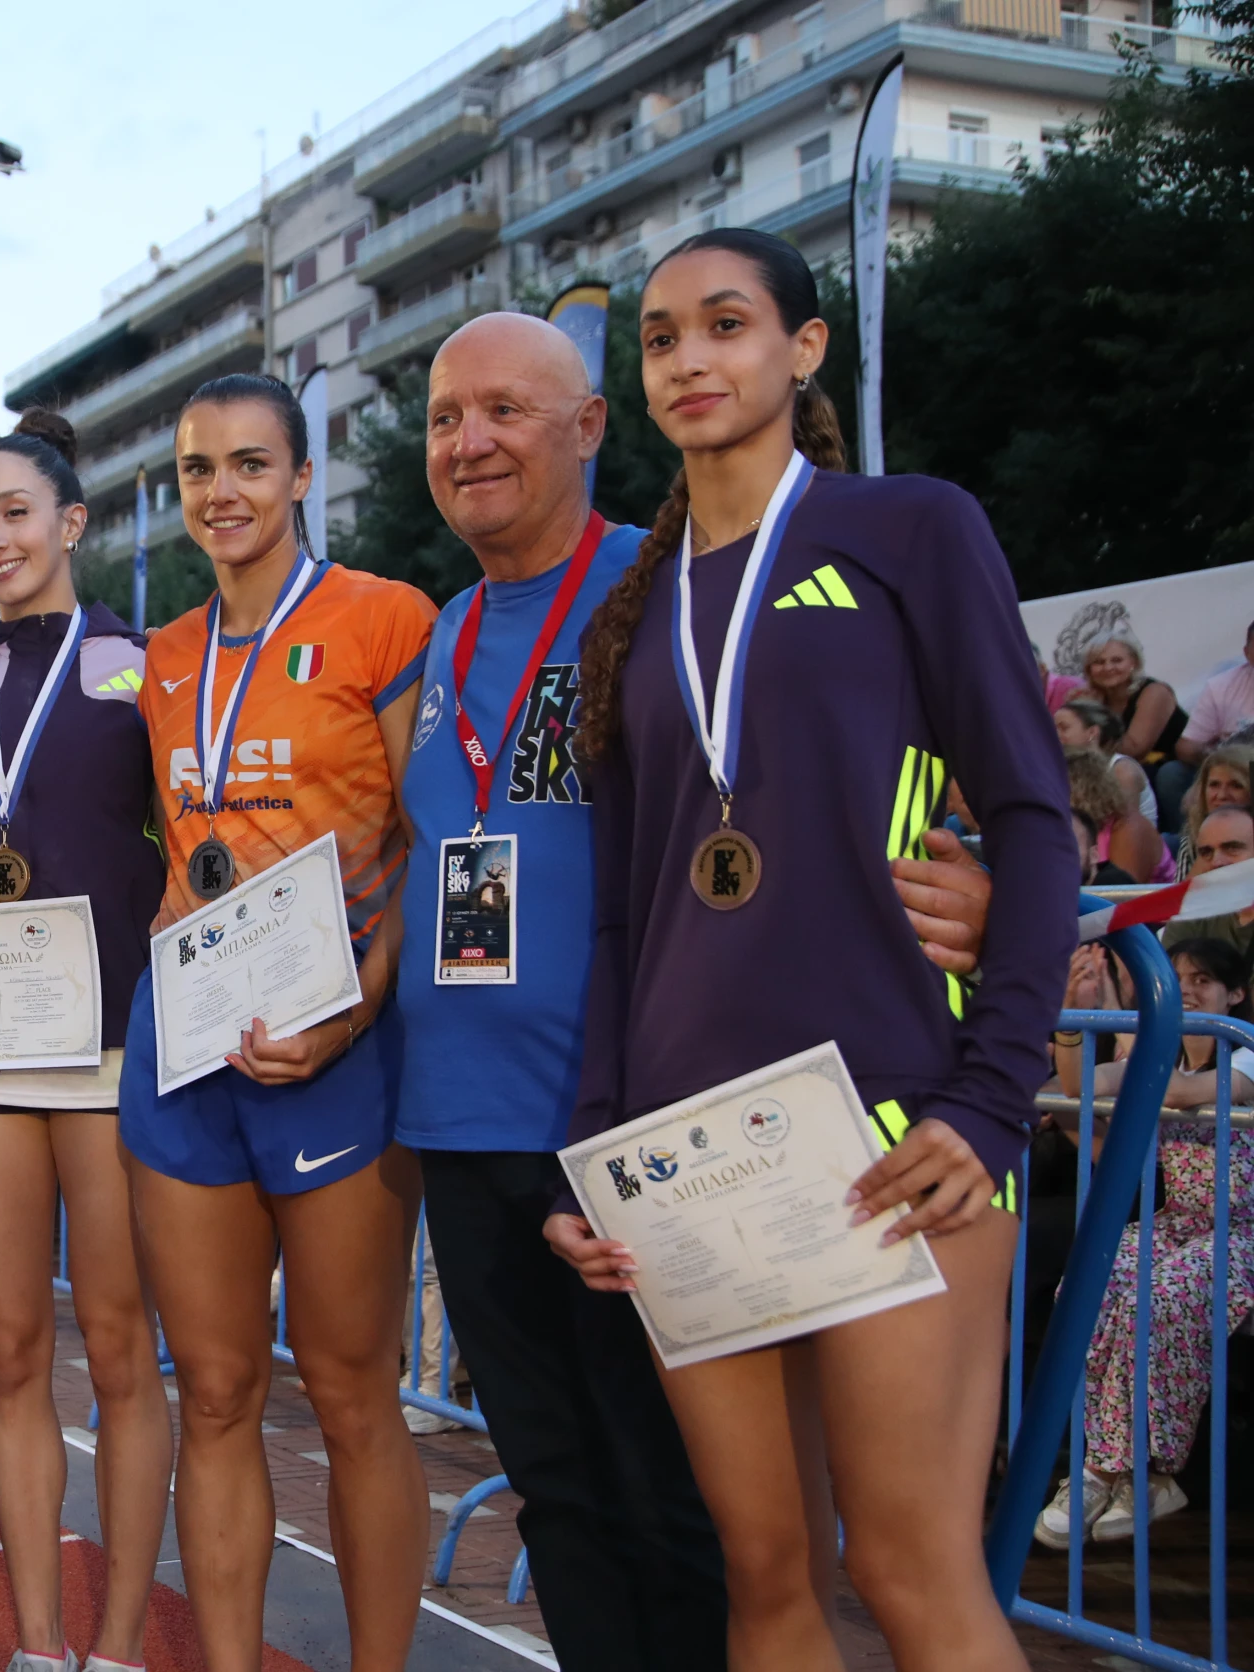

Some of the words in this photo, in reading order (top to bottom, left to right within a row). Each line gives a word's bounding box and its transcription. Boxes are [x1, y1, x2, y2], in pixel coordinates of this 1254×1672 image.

[464, 735, 488, 767] XIXO
[449, 855, 466, 865] FLY
[447, 871, 470, 882] SKG
[447, 880, 471, 893] SKY
[214, 917, 281, 963] ΔΙΠΛΩΜΑ
[234, 941, 262, 958] DIPLOMA
[461, 948, 483, 958] XIXO
[672, 1154, 773, 1204] ΔΙΠΛΩΜΑ
[704, 1183, 746, 1202] DIPLOMA
